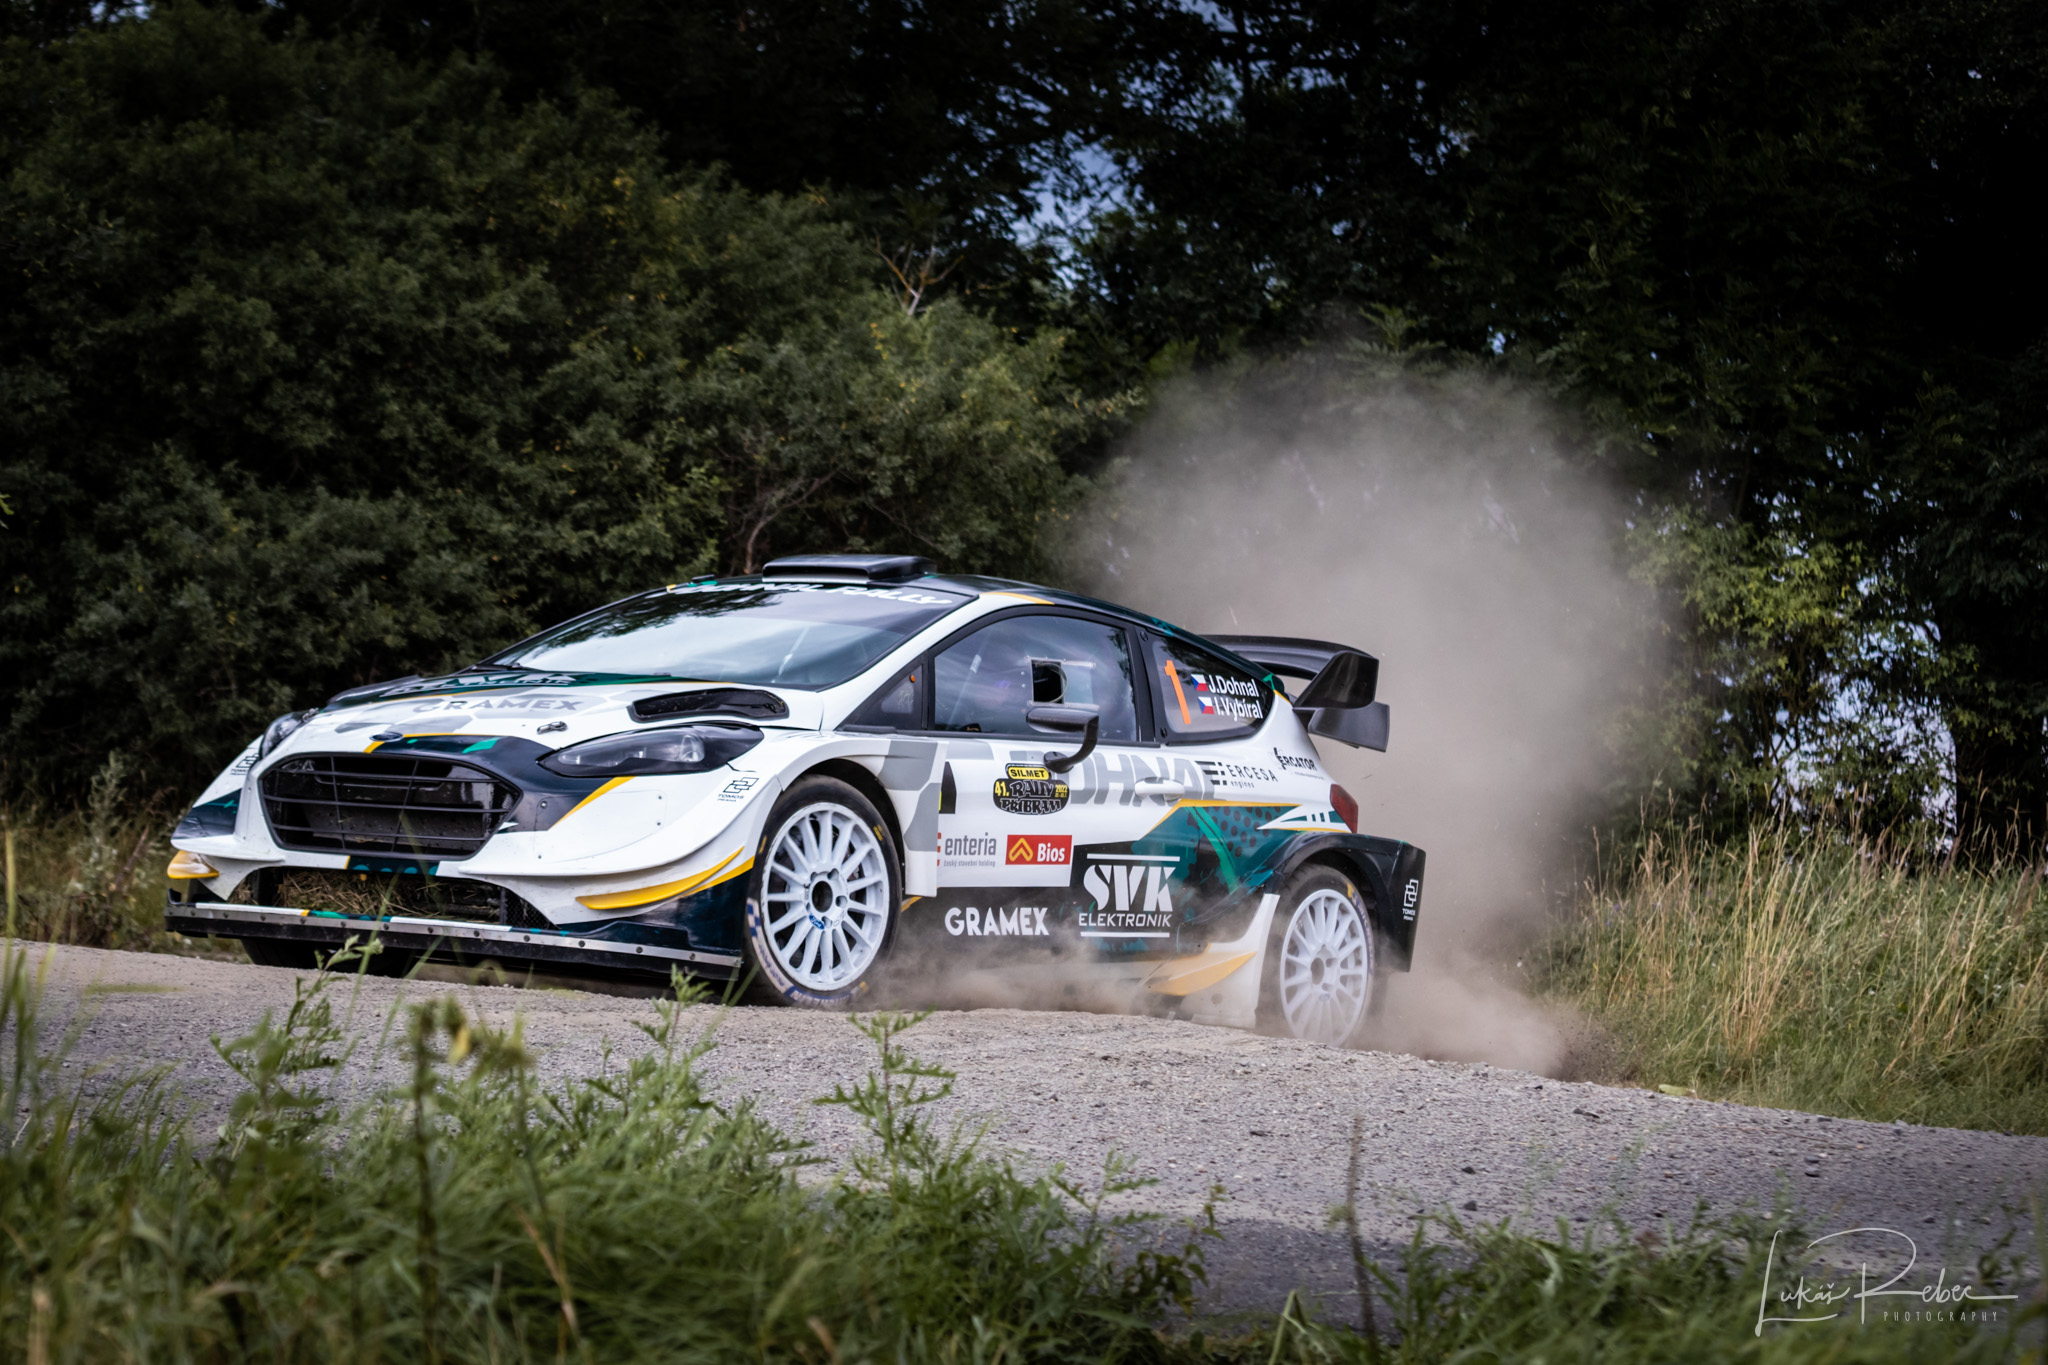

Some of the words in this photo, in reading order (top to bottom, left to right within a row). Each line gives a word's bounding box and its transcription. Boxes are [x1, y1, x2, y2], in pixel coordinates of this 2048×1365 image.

[1164, 660, 1191, 724] 1
[1208, 674, 1259, 697] J.Dohnal
[1213, 696, 1263, 721] I.Vybíral
[1010, 769, 1045, 777] SILMET
[1226, 764, 1278, 782] ERCESA
[994, 781, 1010, 796] 41.
[1010, 780, 1053, 798] RALLY
[944, 832, 997, 856] enteria
[1037, 843, 1066, 862] Bios
[1083, 864, 1177, 912] SVK
[944, 907, 1050, 936] GRAMEX
[1078, 912, 1171, 927] ELEKTRONIK
